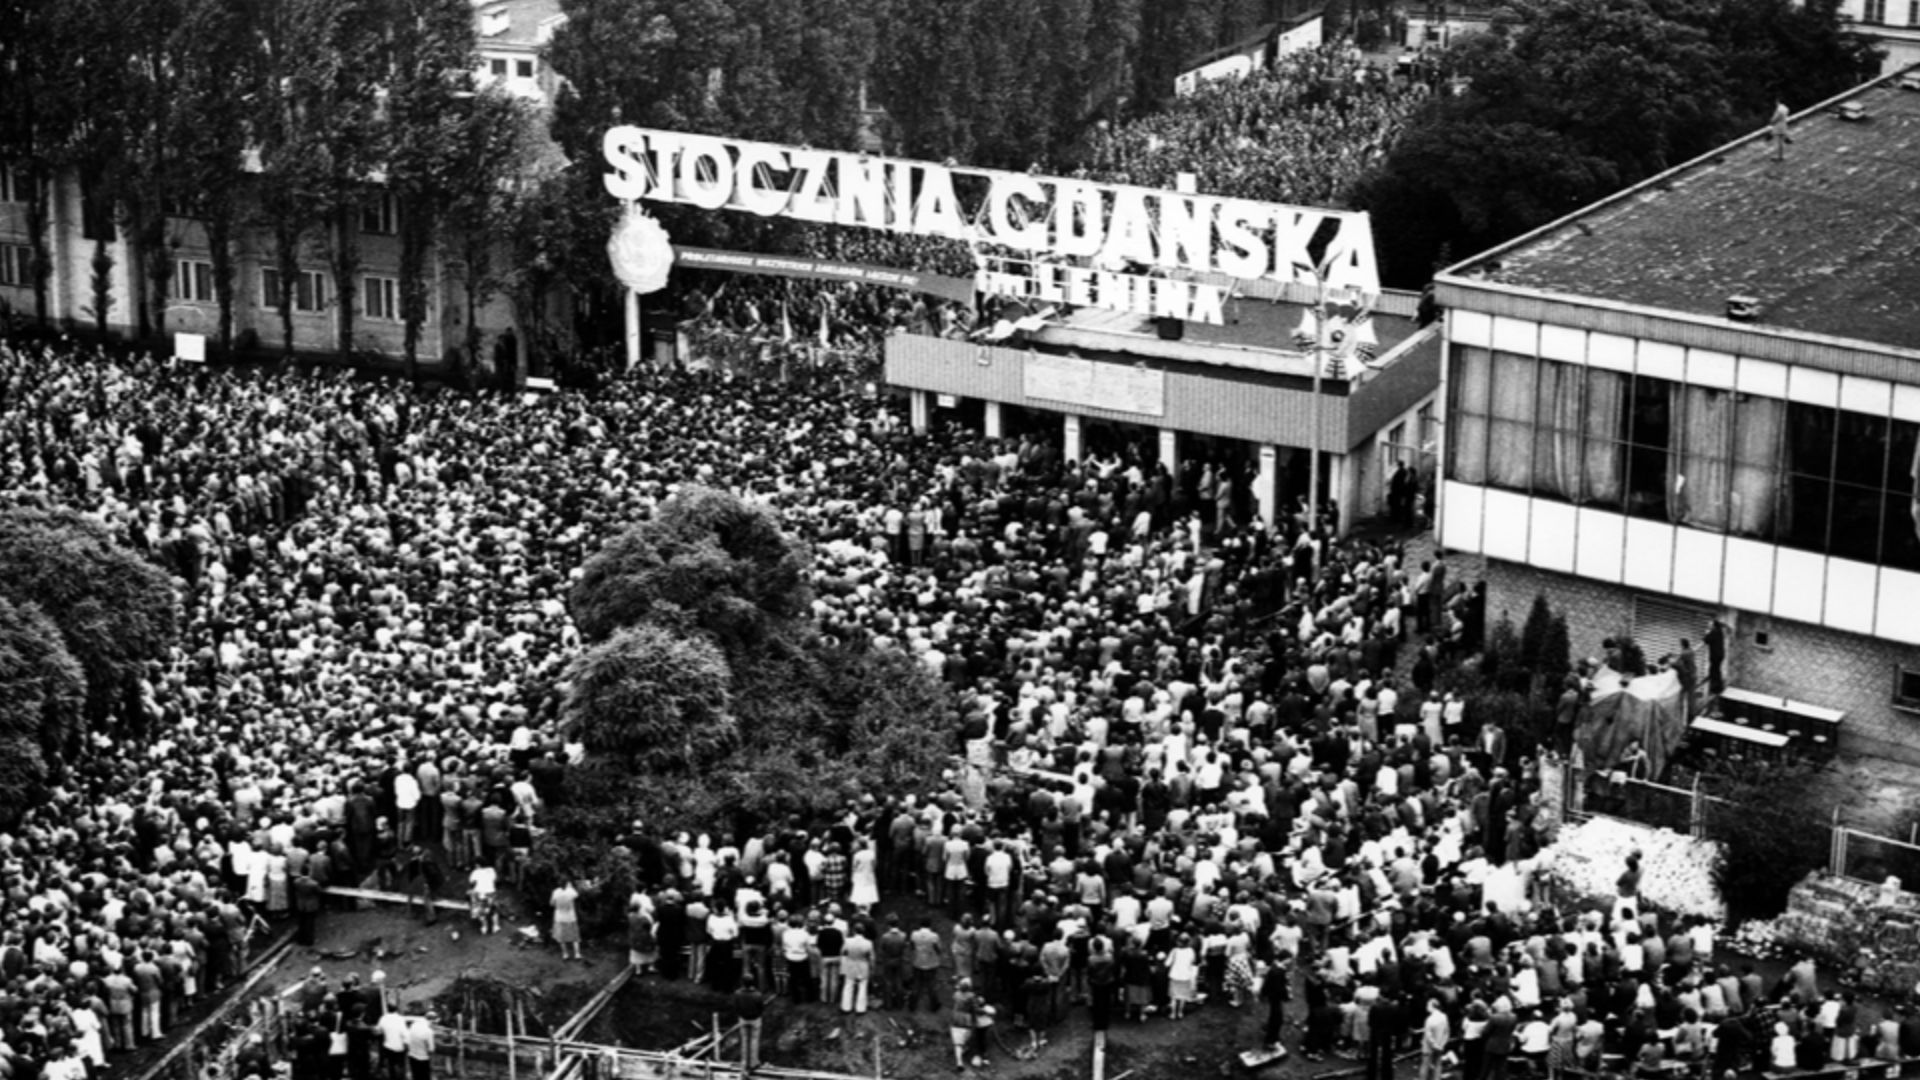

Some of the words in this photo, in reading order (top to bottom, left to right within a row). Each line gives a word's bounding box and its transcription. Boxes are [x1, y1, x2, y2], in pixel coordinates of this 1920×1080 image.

[603, 125, 967, 239] STOCZNIA
[991, 172, 1381, 295] GDAŃSKA
[1040, 263, 1223, 325] LENINA
